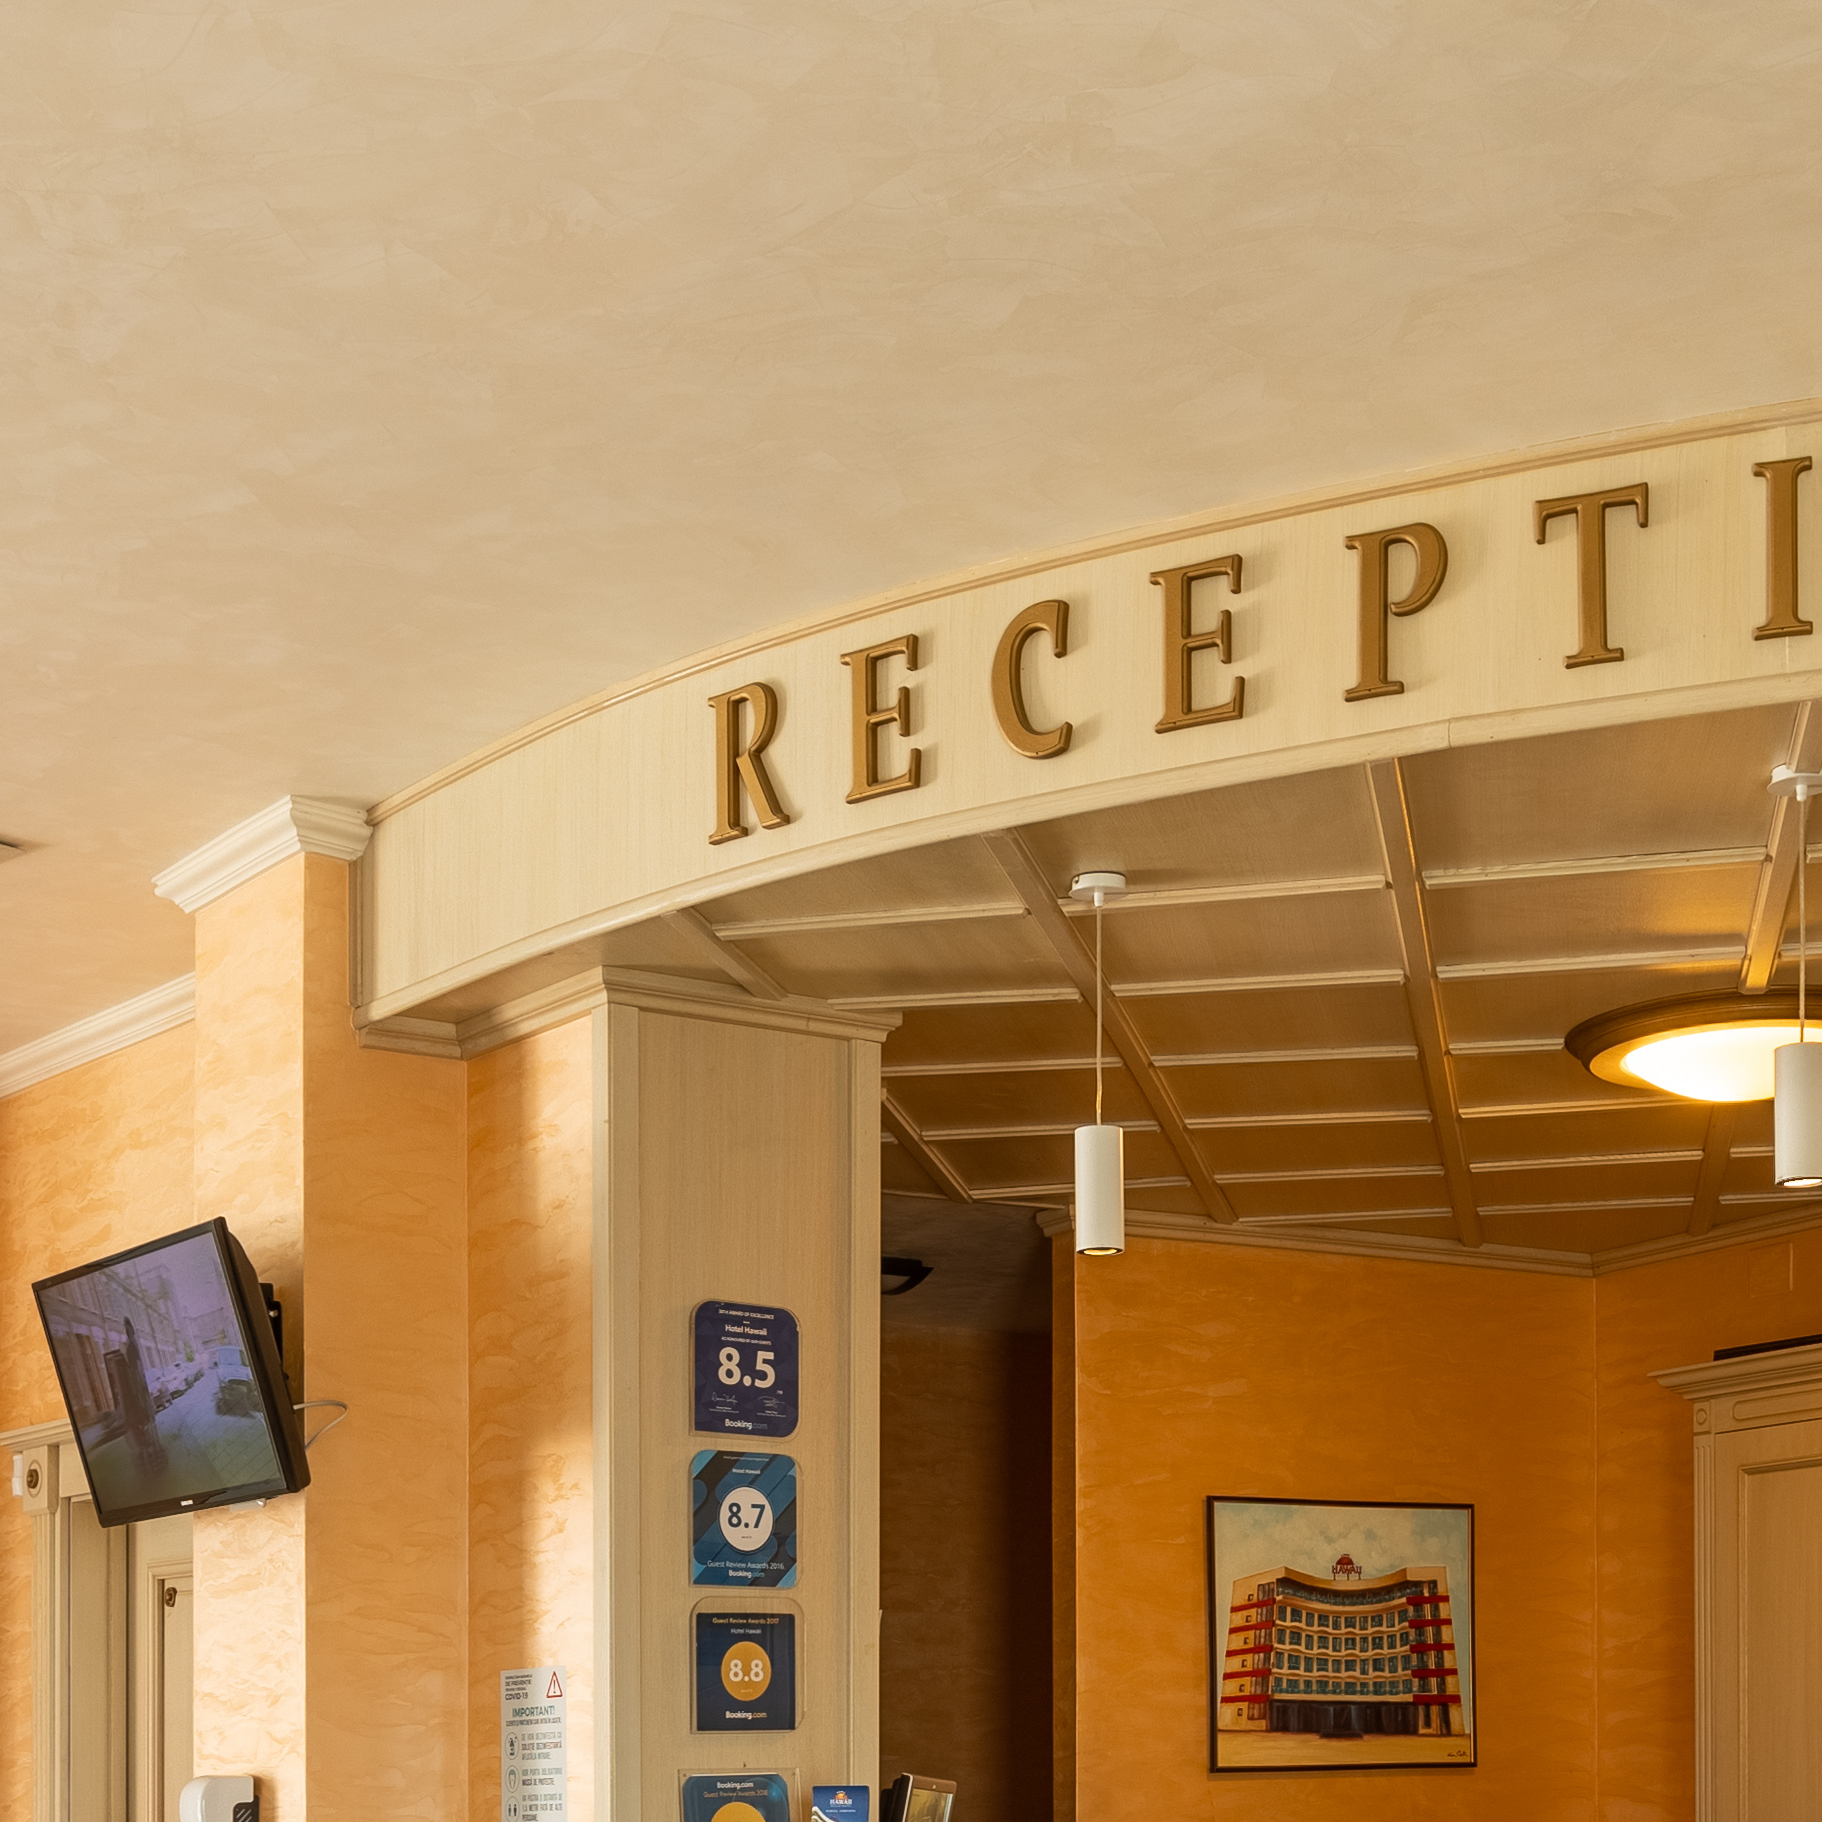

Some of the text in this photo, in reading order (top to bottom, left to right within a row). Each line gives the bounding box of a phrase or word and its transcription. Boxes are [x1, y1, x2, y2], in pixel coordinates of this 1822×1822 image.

[725, 1324, 767, 1336] Hotel Hawaii
[718, 1346, 776, 1388] 8.5
[724, 1418, 768, 1430] Booking.com
[728, 1502, 766, 1529] 8.7
[707, 1560, 725, 1568] Guest
[728, 1570, 765, 1578] Booking.com
[729, 1659, 764, 1682] 8.8
[505, 1692, 528, 1701] COVID-19
[512, 1705, 555, 1718] IMPORTANT!
[726, 1710, 767, 1720] Booking.com
[717, 1781, 754, 1790] Booking.com
